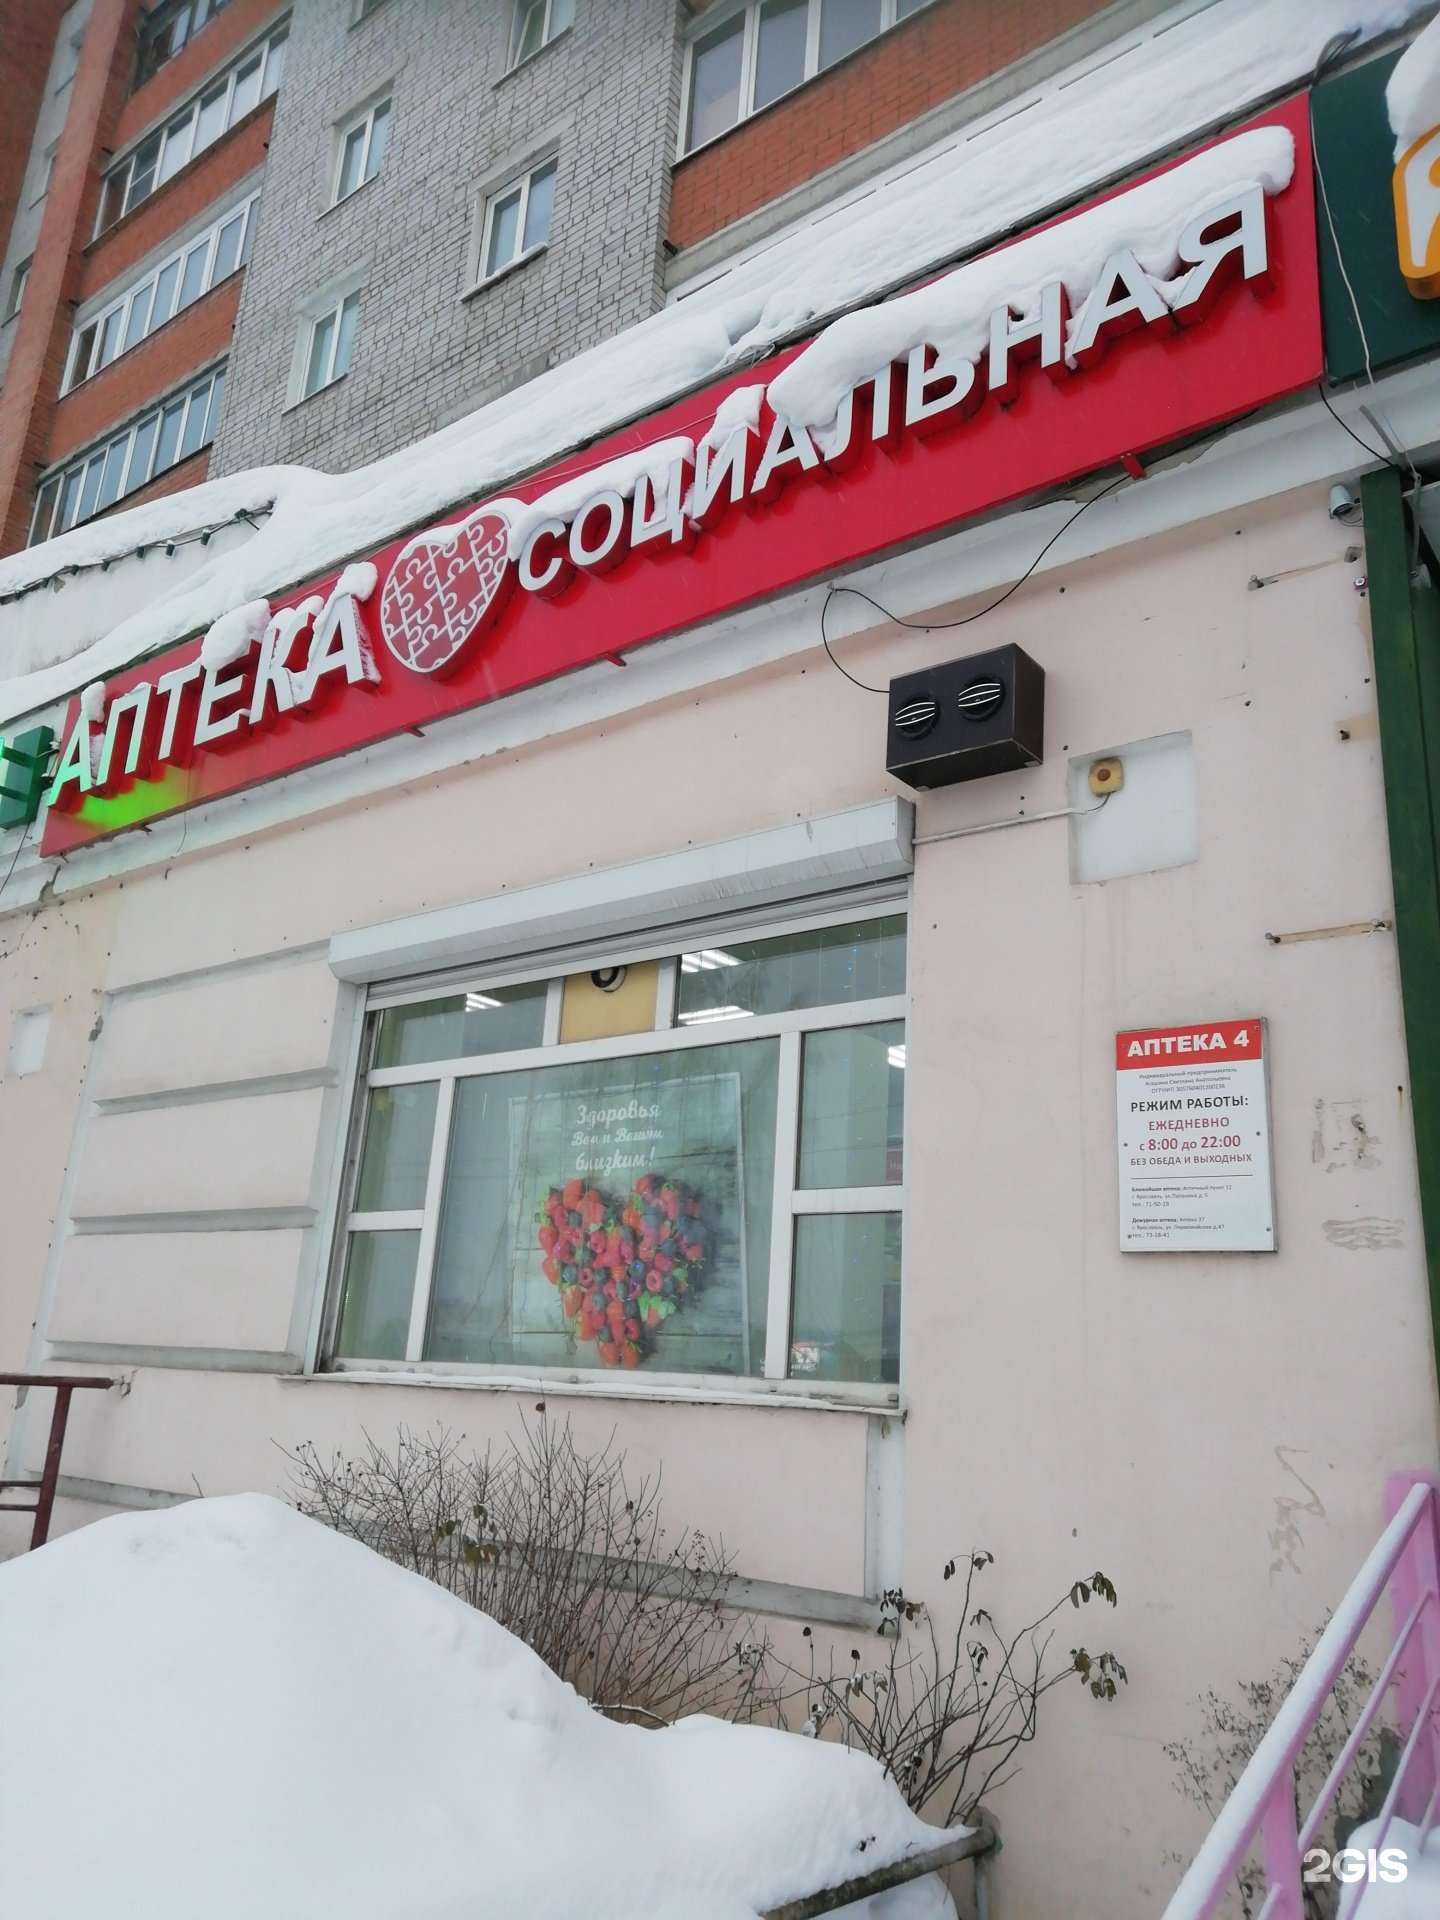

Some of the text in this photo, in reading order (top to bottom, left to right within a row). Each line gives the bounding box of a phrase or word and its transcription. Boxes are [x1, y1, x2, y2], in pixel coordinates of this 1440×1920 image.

[48, 594, 365, 806] АПТЕКА
[517, 183, 1268, 592] СОЦИАЛЬНАЯ
[1128, 1030, 1250, 1057] АПТЕКА 4
[1131, 1096, 1249, 1112] РЕЖИМ РАБОТЫ:
[577, 1099, 662, 1129] Здоровья
[1149, 1117, 1230, 1131] ЕЖЕДНЕВНО
[571, 1127, 664, 1146] Вам и Вашим
[1139, 1135, 1241, 1152] с 8:00 до 22:00
[576, 1146, 656, 1176] близким!
[1130, 1153, 1252, 1167] БЕЗ ОБЕДА И ВЫХОДНЫХ
